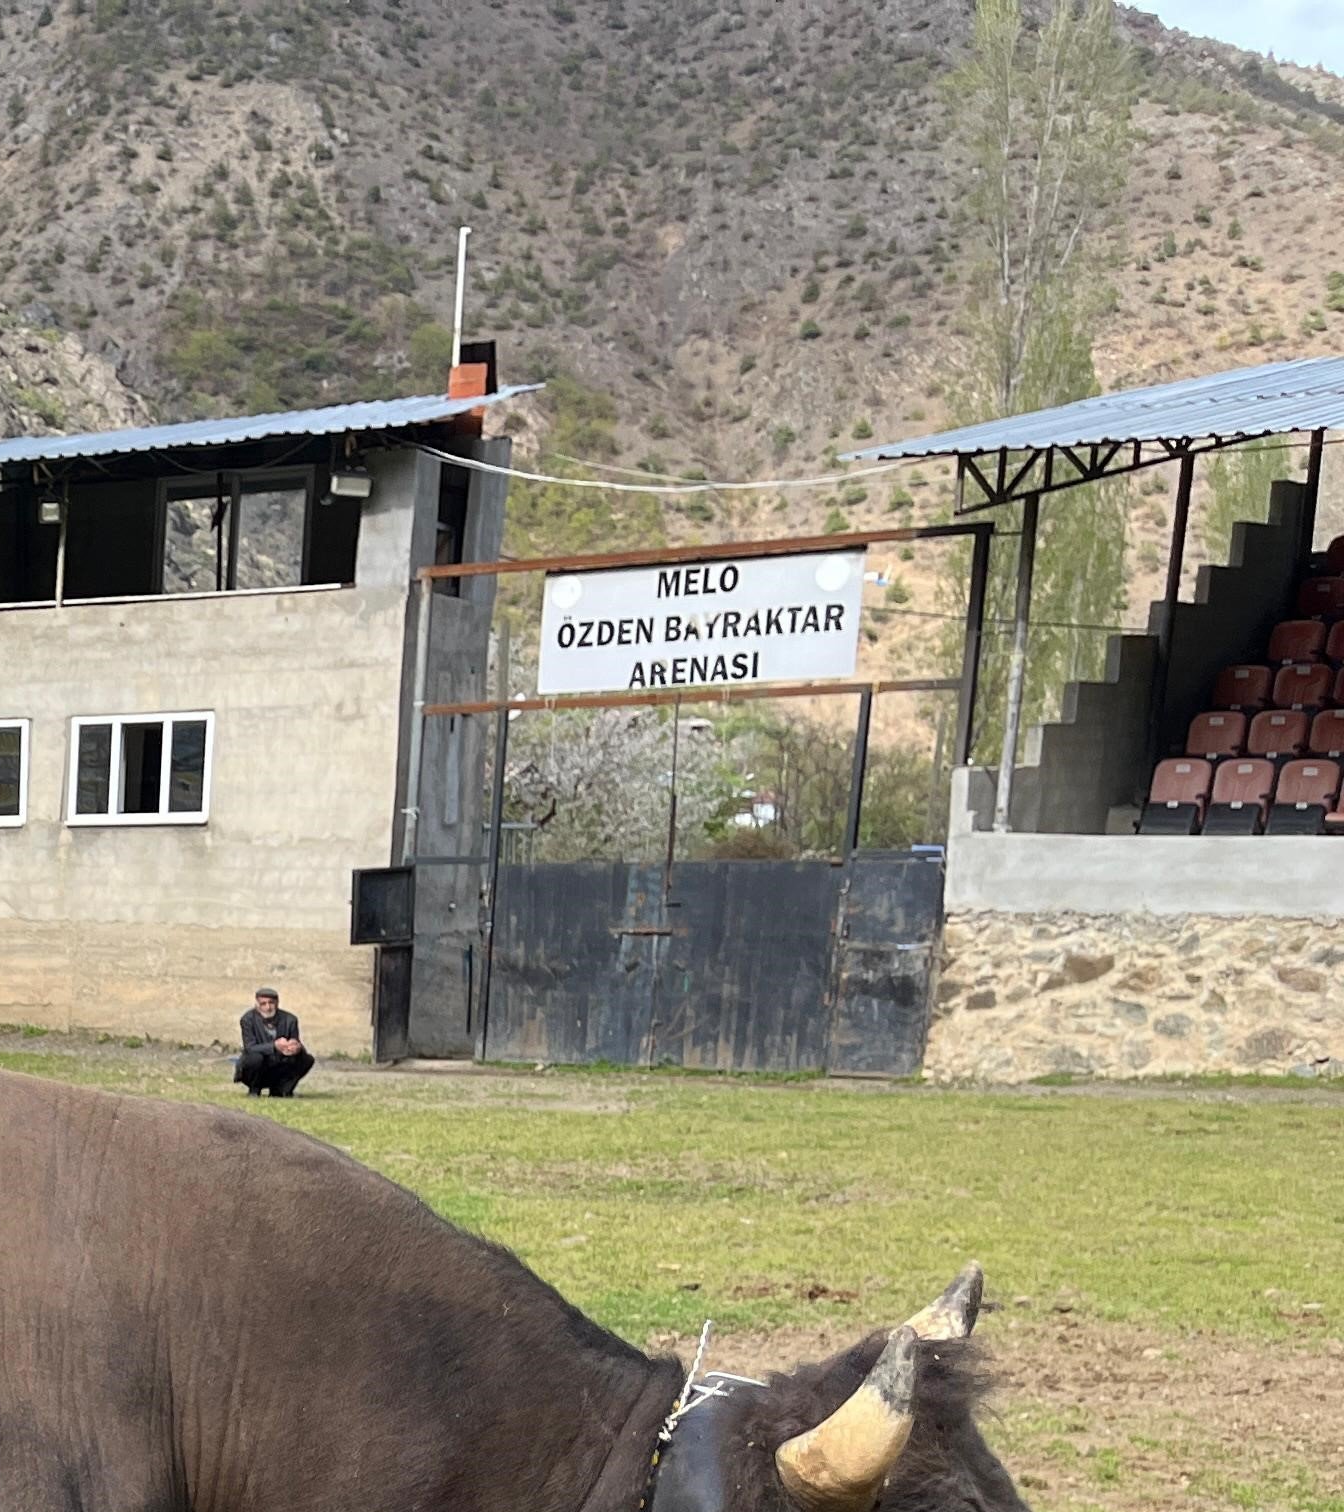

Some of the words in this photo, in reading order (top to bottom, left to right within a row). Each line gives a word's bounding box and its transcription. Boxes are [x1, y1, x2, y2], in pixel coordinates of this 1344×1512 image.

[657, 565, 740, 599] MELO
[556, 615, 654, 648] ÖZDEN
[664, 604, 845, 642] BAYRAKTAR
[628, 651, 759, 689] ARENASI
